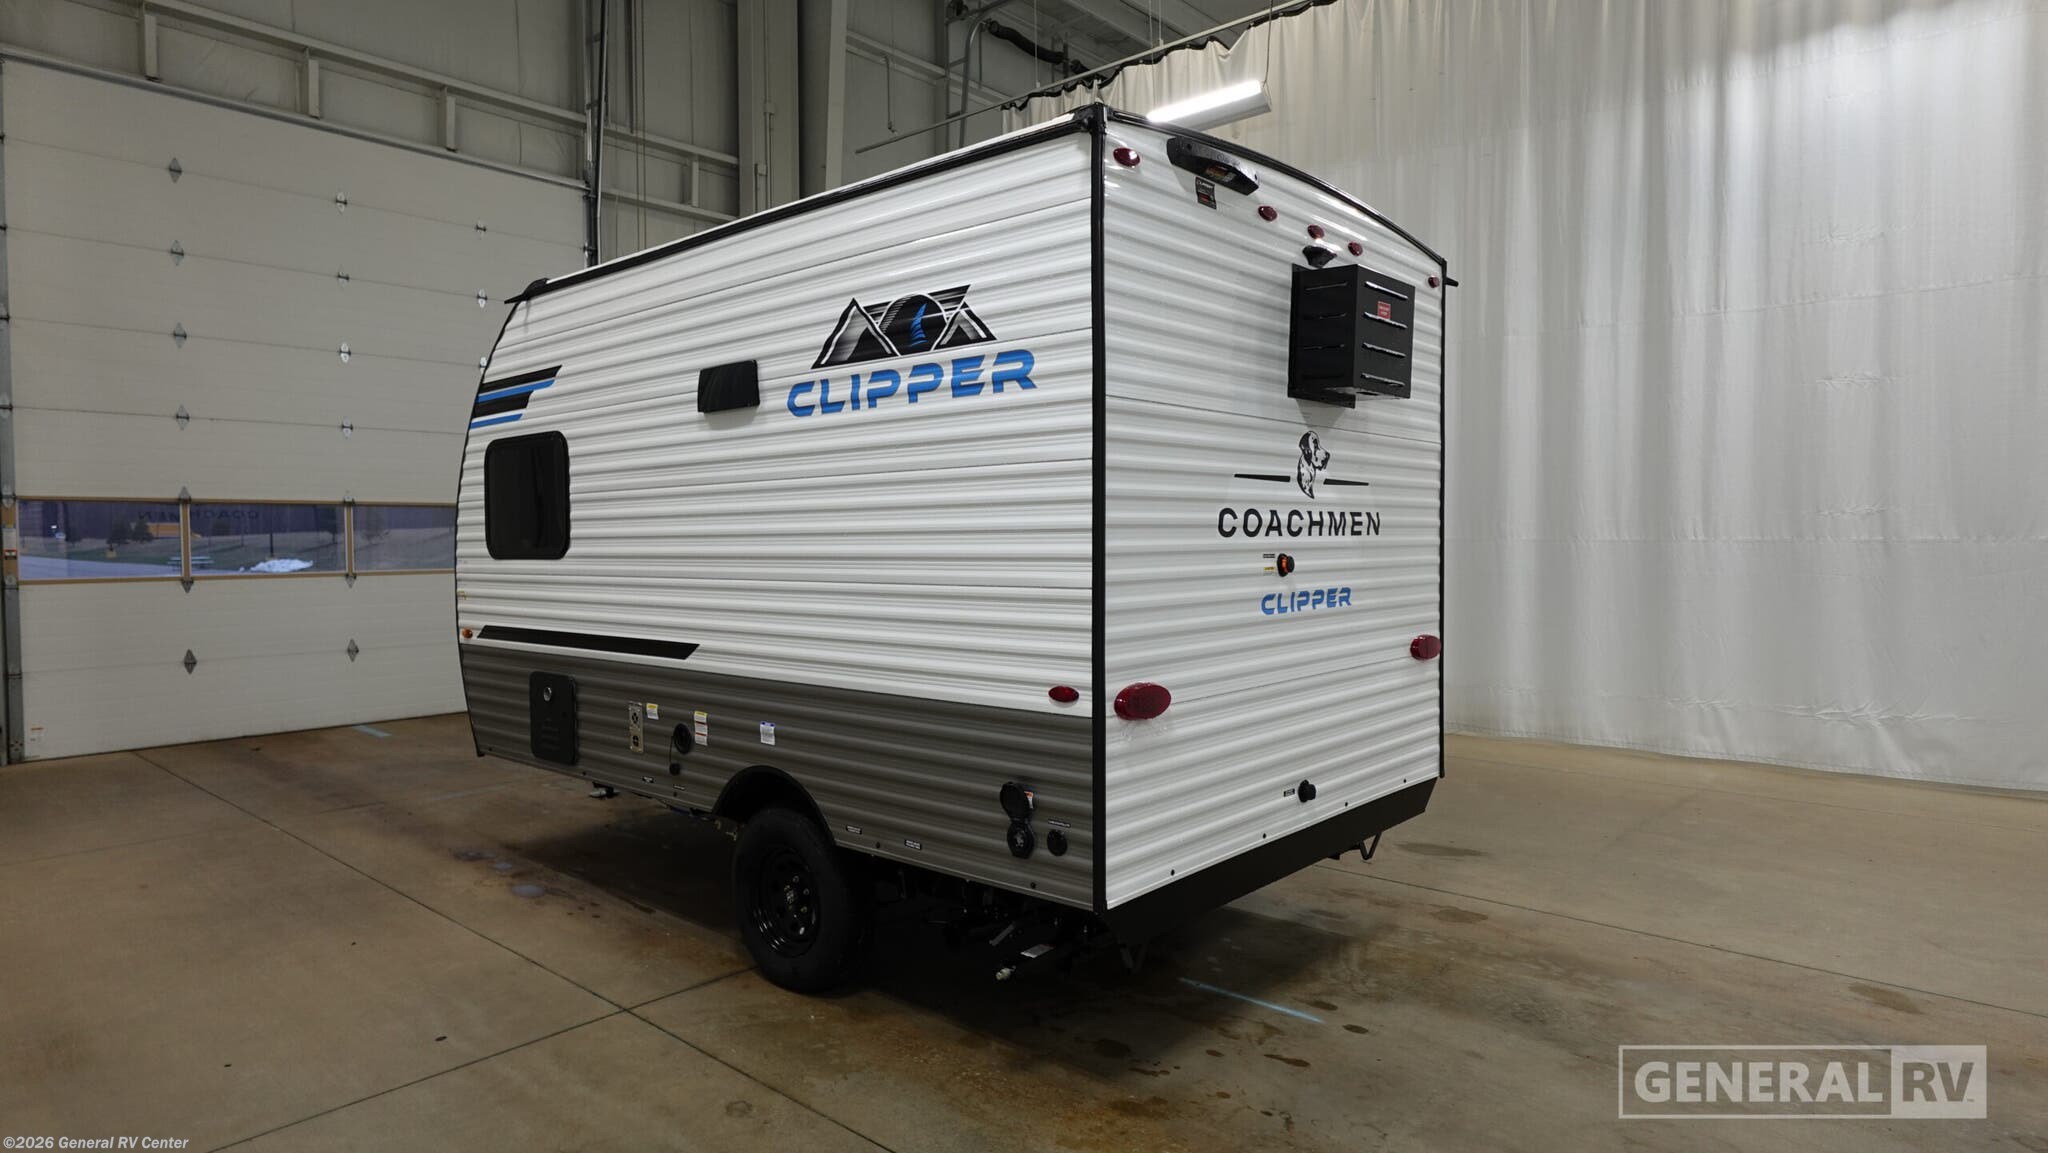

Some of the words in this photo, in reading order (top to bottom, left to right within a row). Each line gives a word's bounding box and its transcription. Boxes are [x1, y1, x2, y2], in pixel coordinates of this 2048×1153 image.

[787, 349, 1037, 417] CLIPPER
[1218, 507, 1381, 538] COACHMEN
[1261, 587, 1352, 615] CLIPPER
